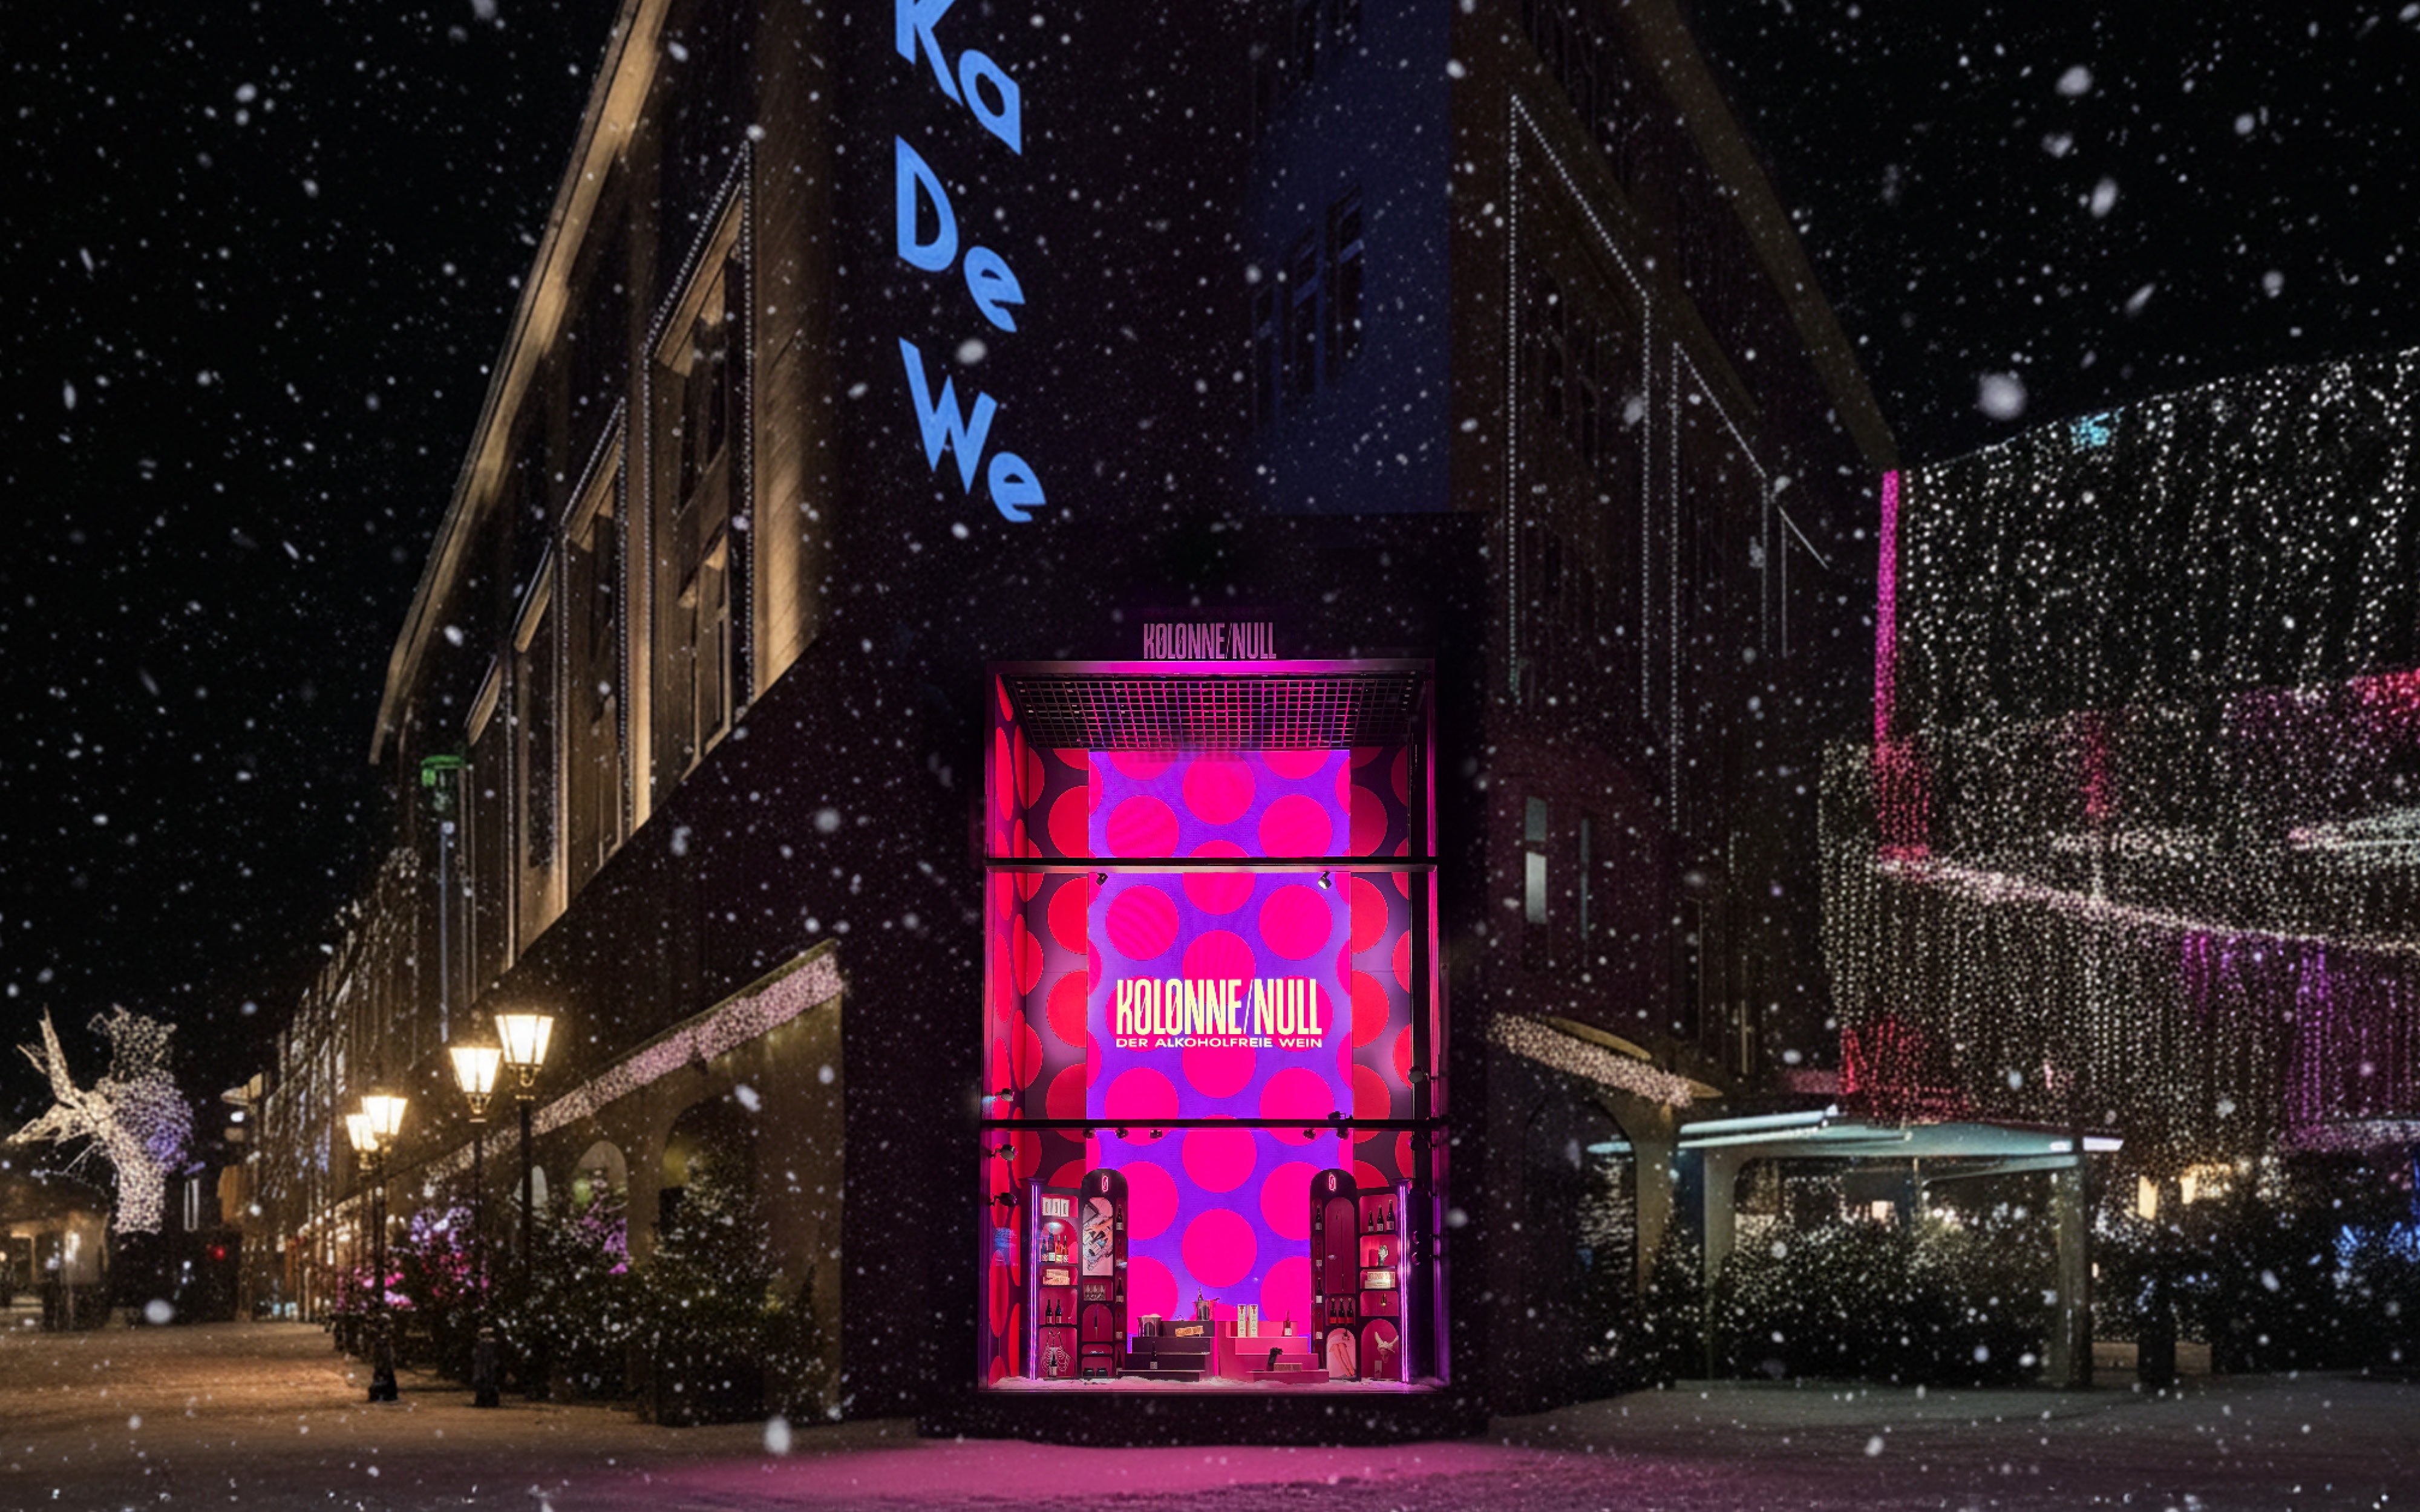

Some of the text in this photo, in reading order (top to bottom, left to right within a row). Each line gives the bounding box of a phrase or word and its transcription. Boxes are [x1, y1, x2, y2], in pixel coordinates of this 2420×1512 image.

[1116, 1037, 1323, 1048] DER ALKOHOLFREIE WEIN
